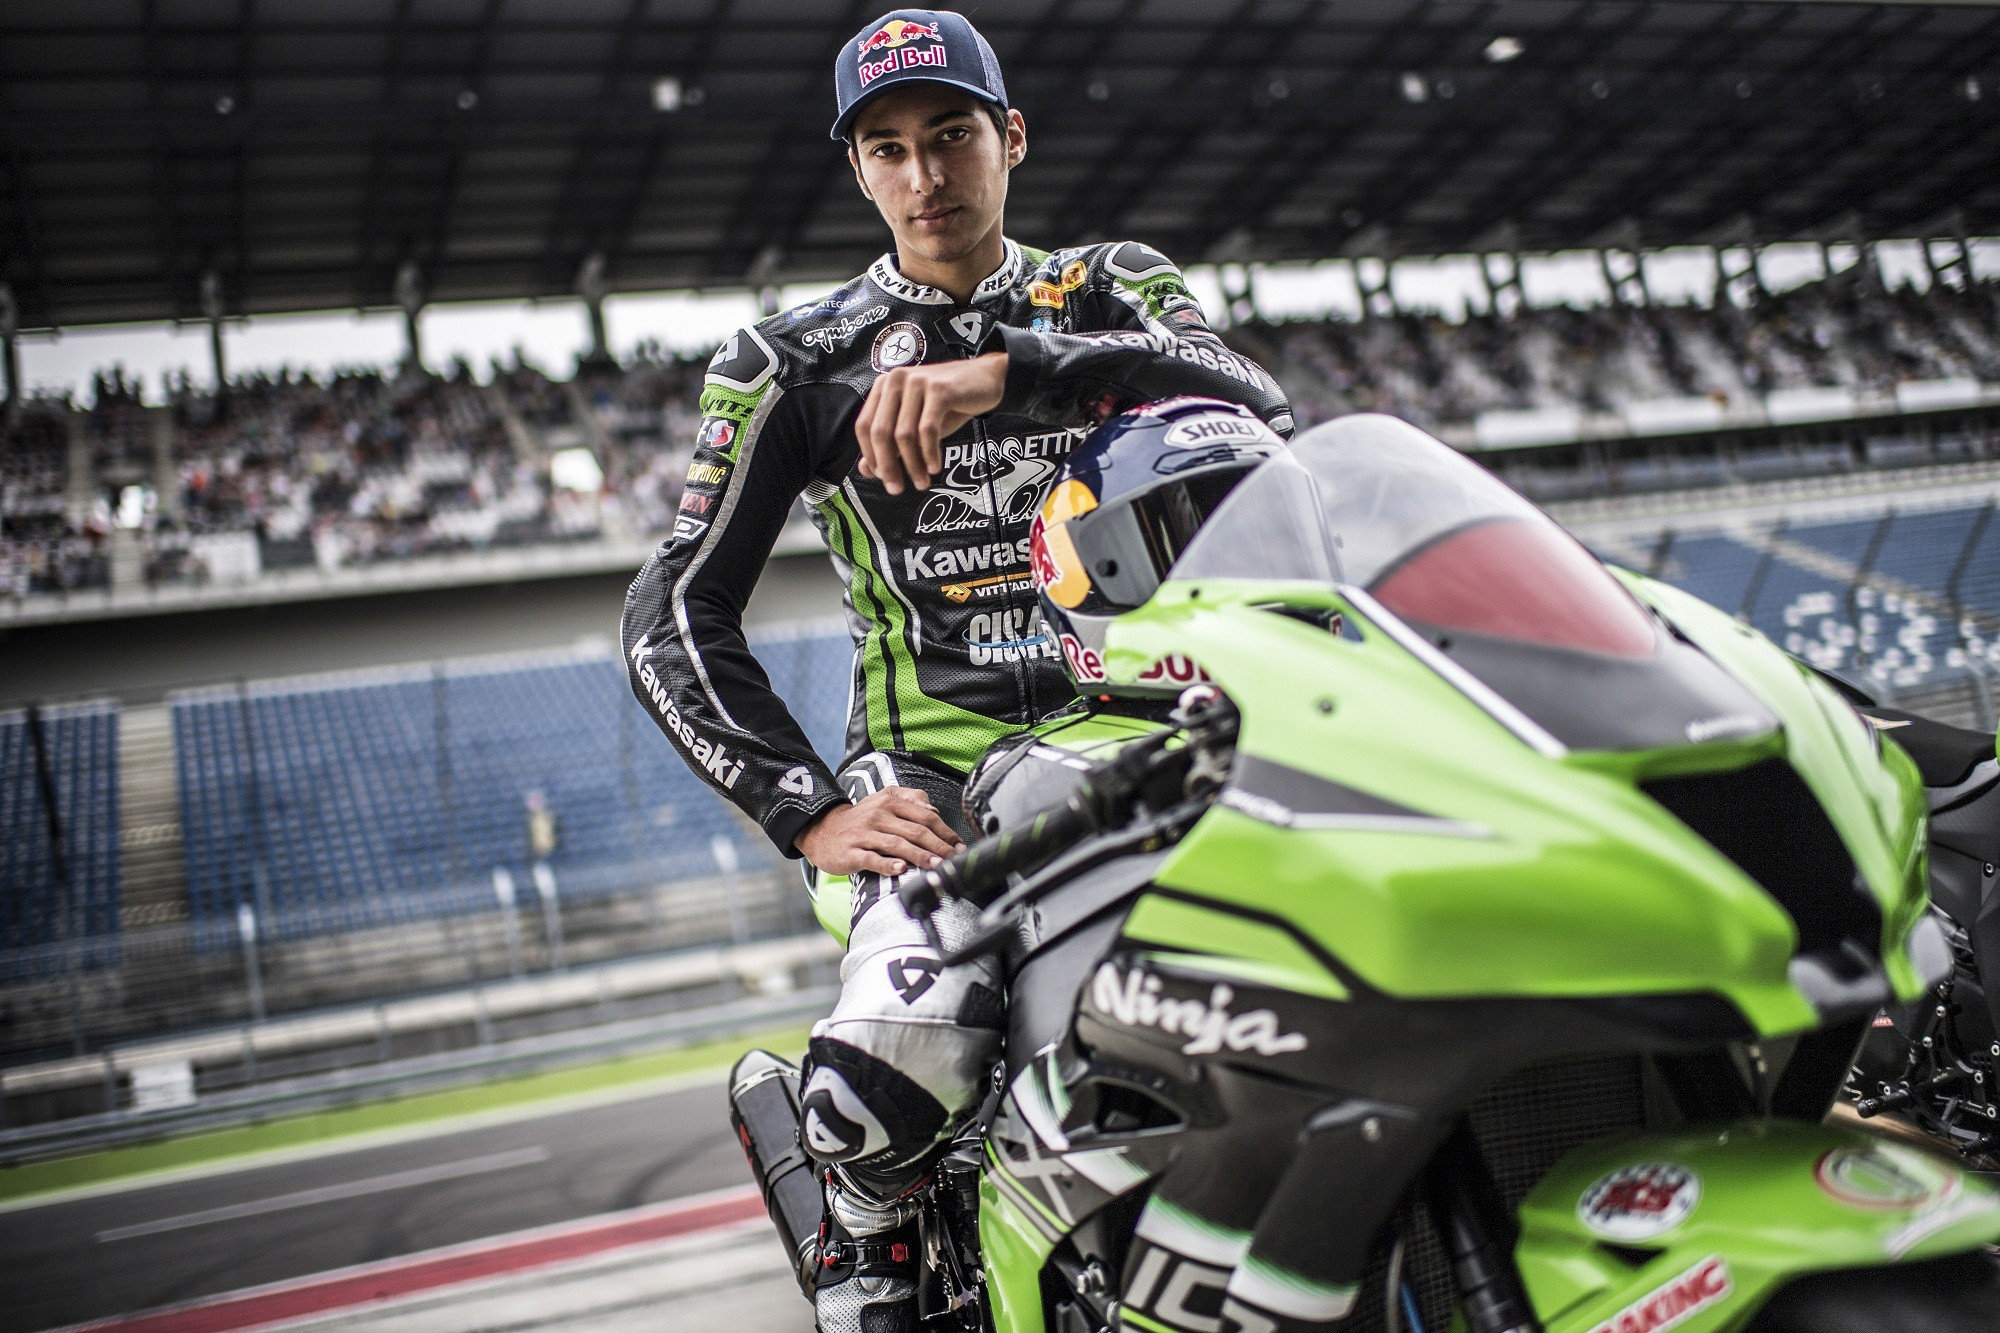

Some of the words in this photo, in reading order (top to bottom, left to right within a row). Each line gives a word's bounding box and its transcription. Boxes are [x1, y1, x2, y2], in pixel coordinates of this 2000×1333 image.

[859, 51, 899, 87] Red
[902, 46, 946, 68] Bull
[1086, 330, 1264, 391] Kawasaki
[1181, 421, 1256, 441] SHOEI
[915, 518, 990, 534] RACING
[1060, 634, 1106, 682] Re
[631, 634, 746, 790] Kawasaki
[1093, 962, 1308, 1056] Ninja
